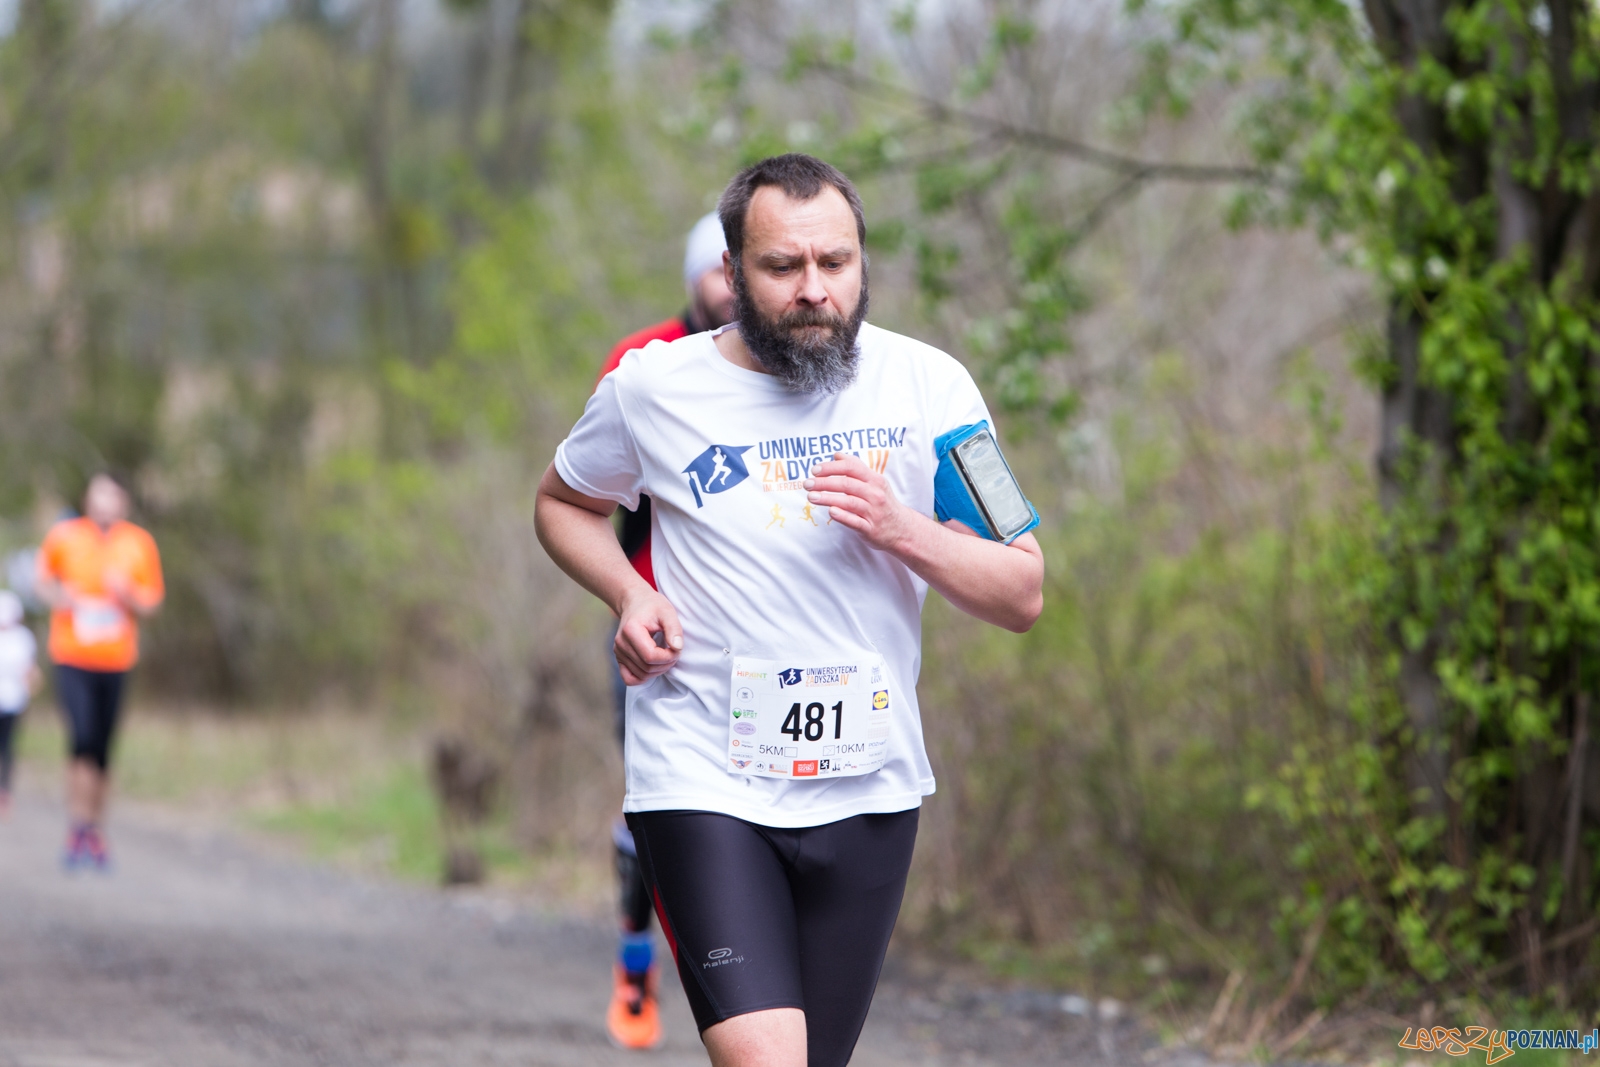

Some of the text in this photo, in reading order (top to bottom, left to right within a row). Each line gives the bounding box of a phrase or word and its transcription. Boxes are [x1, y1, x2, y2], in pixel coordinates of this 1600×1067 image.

[806, 665, 858, 676] UNIWERSYTECKA
[806, 673, 850, 686] ZADYSZKA IV
[780, 700, 843, 742] 481
[759, 744, 784, 756] 5KM
[836, 742, 865, 755] 10KM
[702, 955, 744, 970] Kalenji
